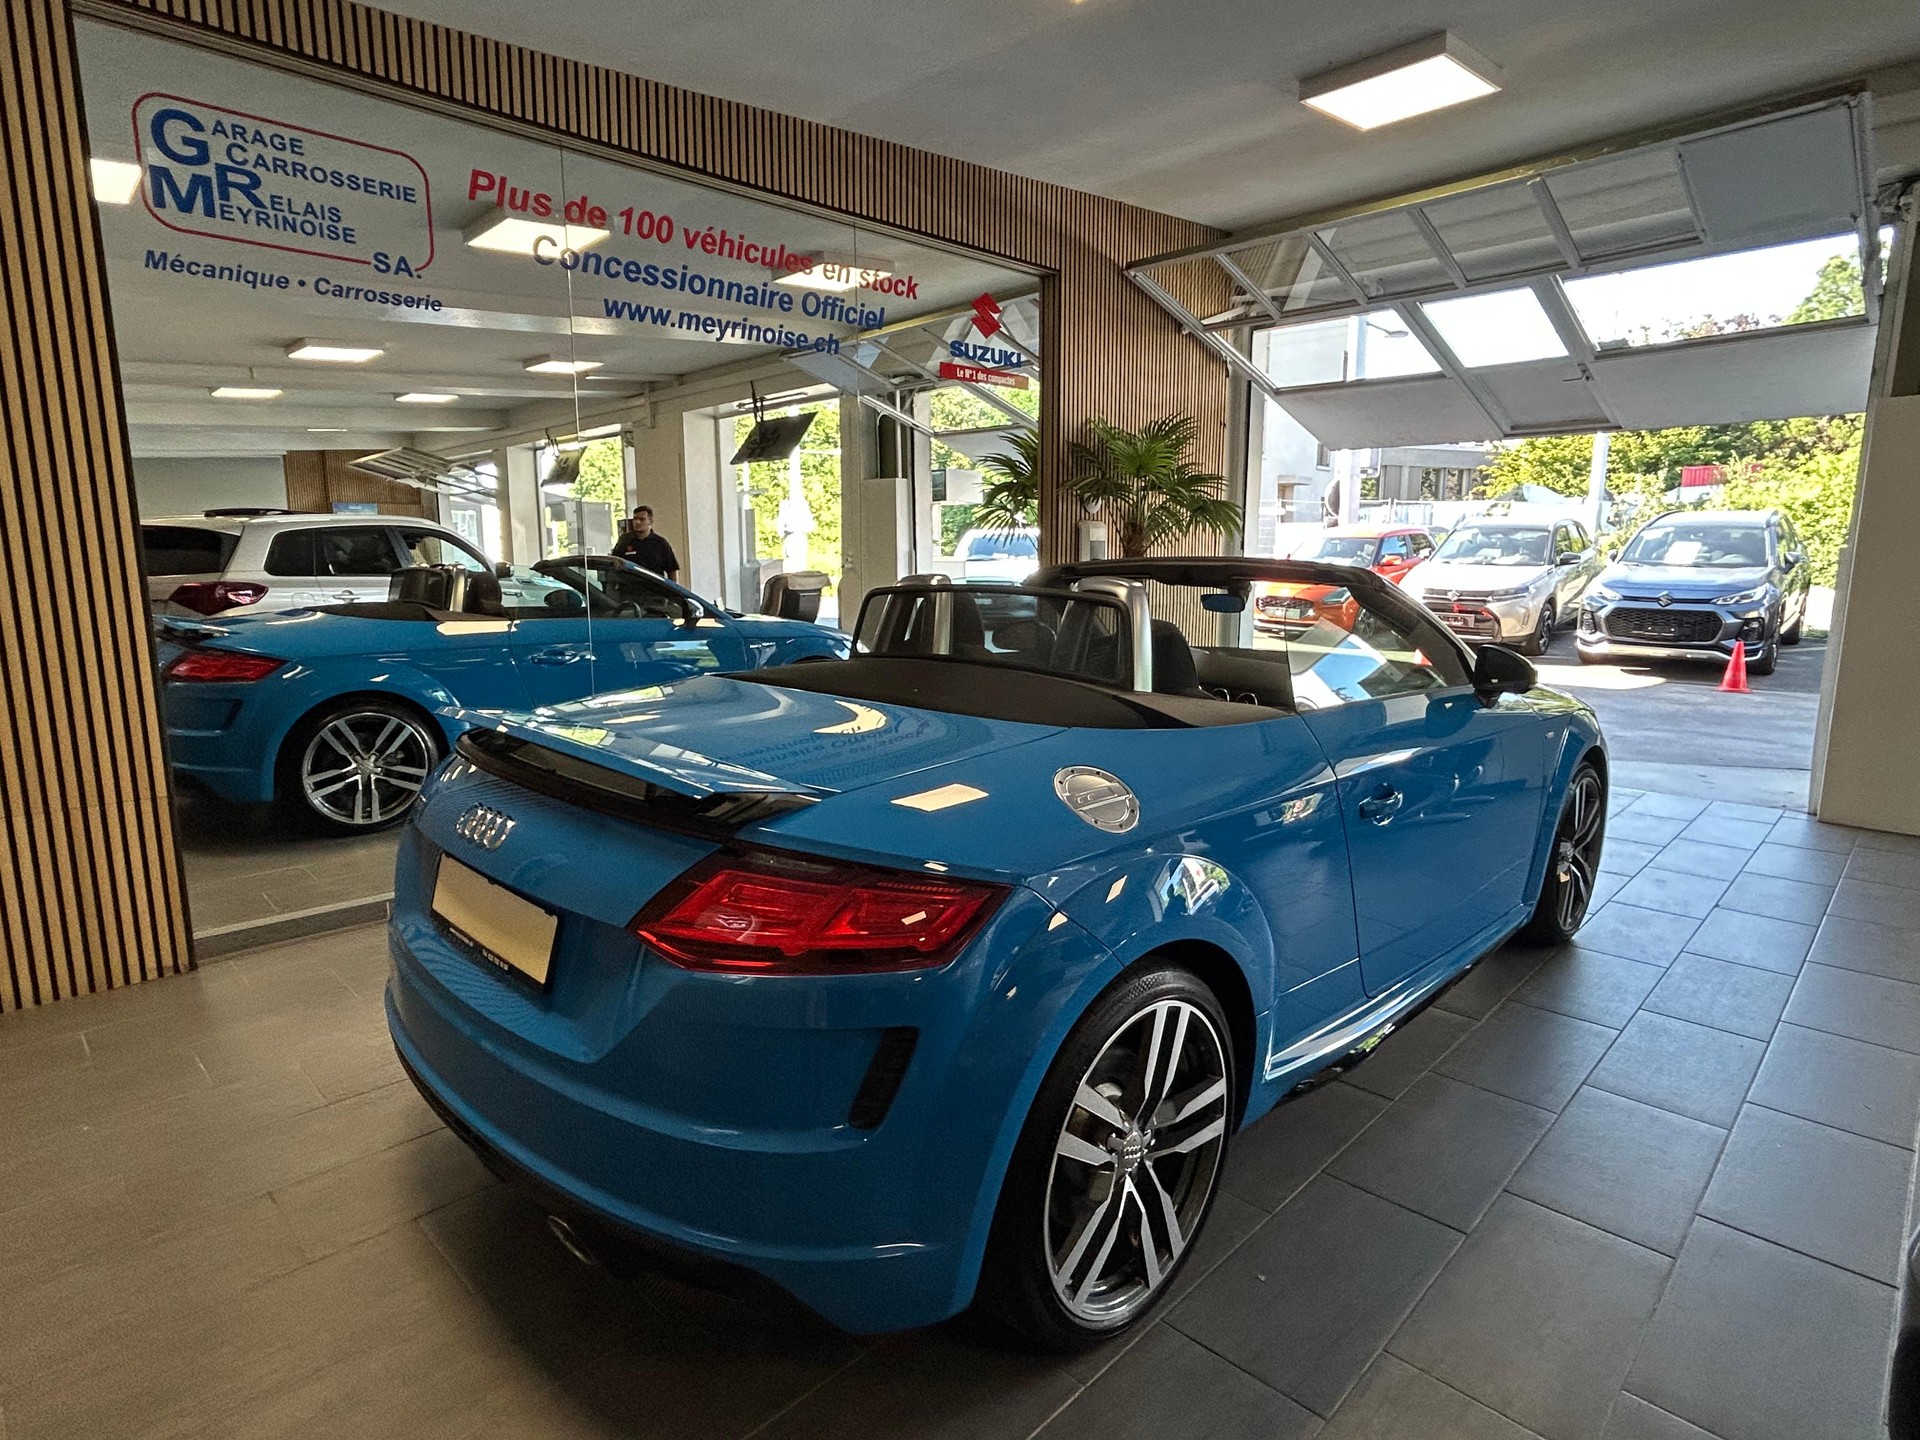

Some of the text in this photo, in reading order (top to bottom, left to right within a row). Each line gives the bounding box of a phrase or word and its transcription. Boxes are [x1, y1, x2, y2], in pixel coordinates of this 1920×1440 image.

[151, 108, 304, 167] GARAGE
[215, 162, 342, 223] RELAIS
[226, 143, 417, 203] CARROSSERIE
[150, 164, 356, 244] MEYRINOISE
[468, 168, 919, 300] Plus de 100 véhicules en stock
[144, 249, 443, 312] Mécanique Carrosserie
[373, 252, 422, 279] SA.
[532, 235, 886, 330] Concessionnaire Officiel
[603, 298, 840, 355] www.meyrinoise.ch
[949, 340, 1022, 368] SUZUKI
